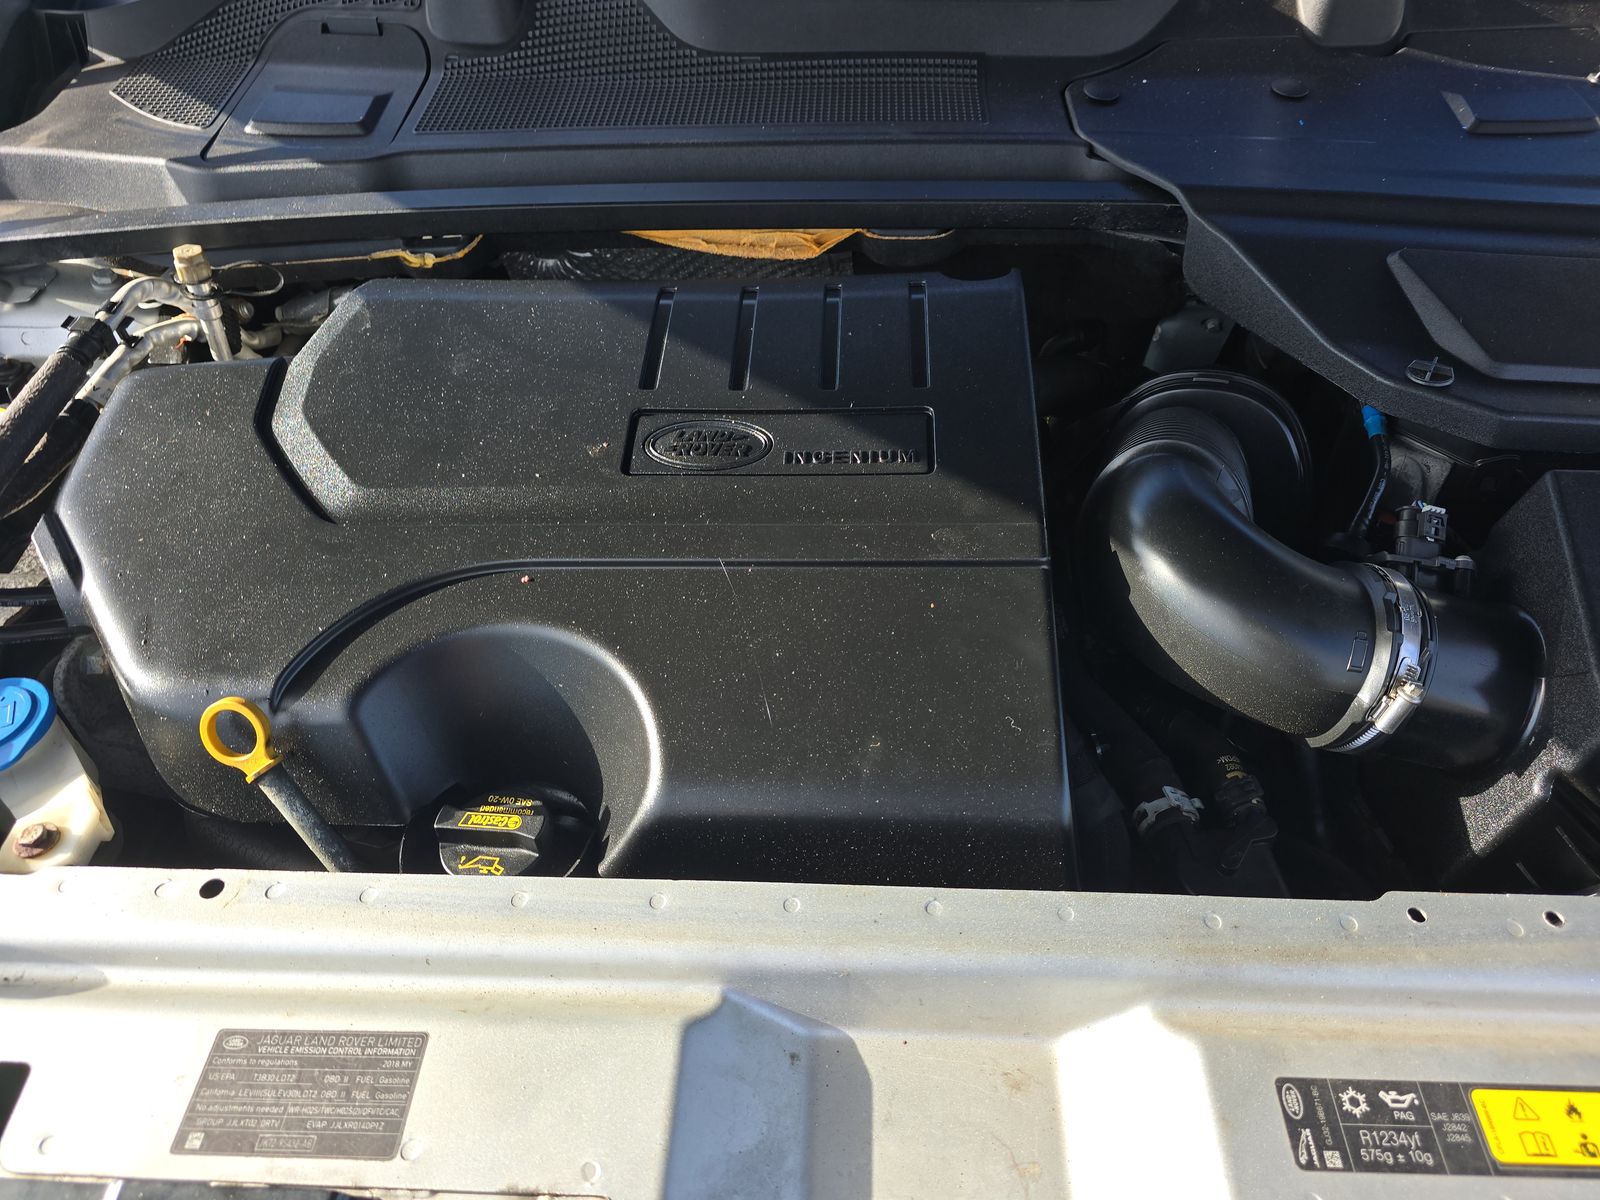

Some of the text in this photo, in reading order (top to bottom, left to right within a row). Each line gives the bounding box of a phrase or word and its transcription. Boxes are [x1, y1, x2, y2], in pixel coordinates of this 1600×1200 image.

[782, 450, 922, 465] INGENIUM
[488, 795, 533, 807] SAE 0W-20
[480, 805, 534, 816] recommended
[468, 814, 507, 828] Castrol
[256, 1035, 302, 1046] JAGUAR
[303, 1036, 336, 1046] LAND
[338, 1036, 376, 1047] ROVER
[377, 1037, 423, 1048] LIMITED
[257, 1046, 417, 1056] VEHICLE EMISSION CONTROL INFORMATION
[212, 1056, 247, 1065] Conforms
[257, 1057, 298, 1066] regulations
[400, 1060, 413, 1068] MY
[355, 1075, 374, 1084] FUEL
[379, 1075, 410, 1084] Gasoline
[351, 1090, 371, 1099] FUEL
[375, 1091, 408, 1100] Gasoline
[207, 1103, 254, 1113] adjustments
[255, 1105, 284, 1113] needed
[1393, 1111, 1415, 1121] PAG
[1430, 1112, 1471, 1121] SAE J639
[1442, 1122, 1468, 1132] J2842
[1359, 1129, 1421, 1147] R1234yf
[1305, 1128, 1320, 1168] JAGUAR
[1360, 1148, 1393, 1164] 575g
[1408, 1150, 1434, 1166] 10g
